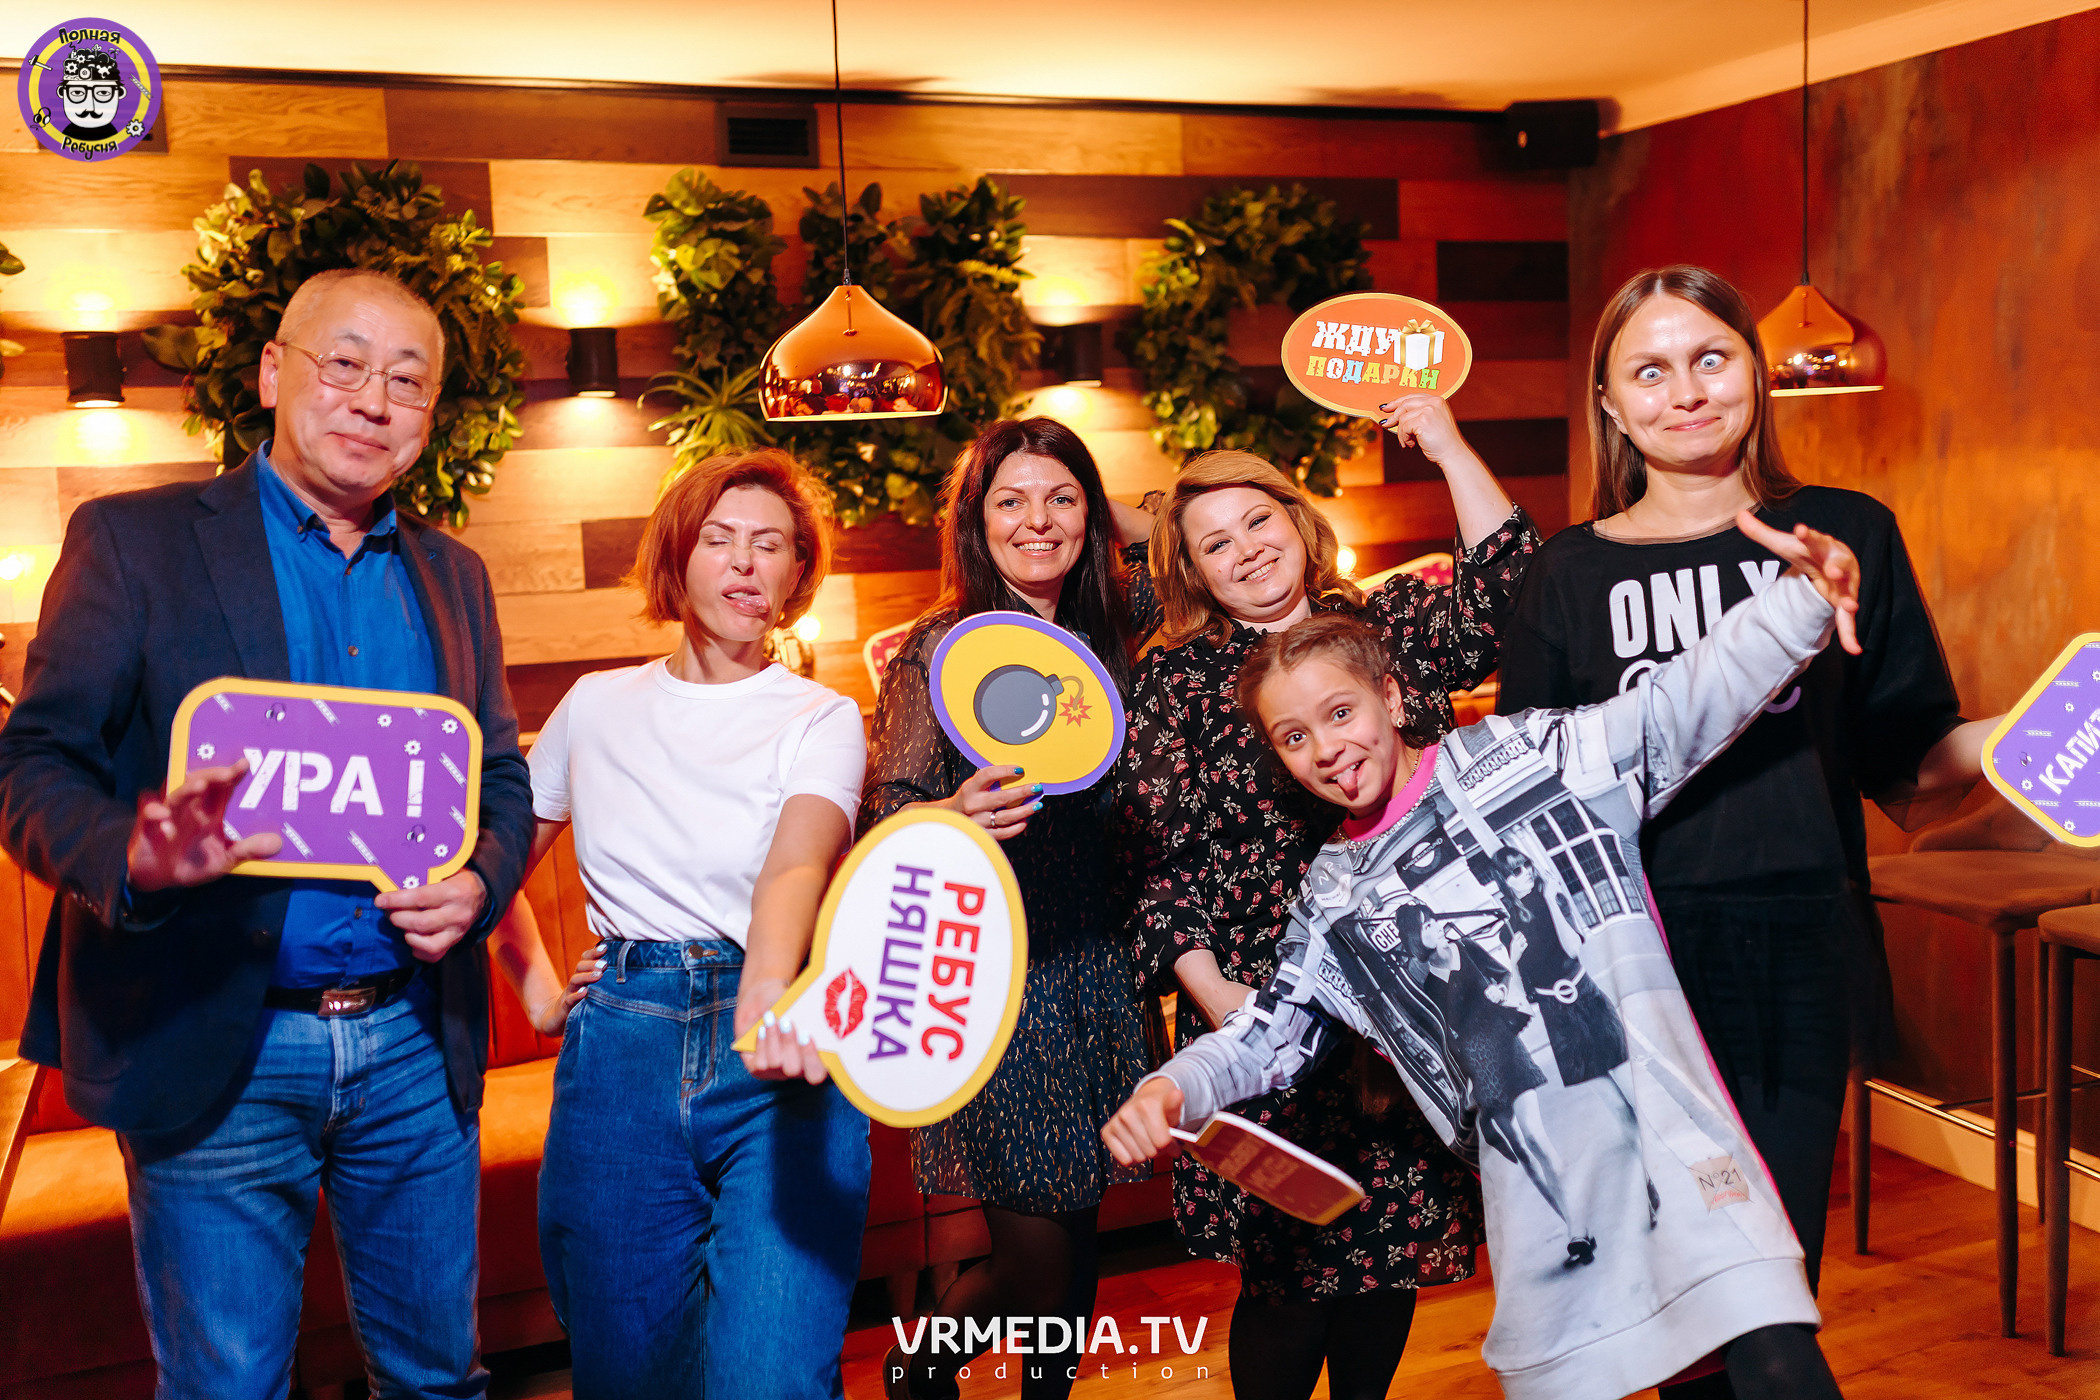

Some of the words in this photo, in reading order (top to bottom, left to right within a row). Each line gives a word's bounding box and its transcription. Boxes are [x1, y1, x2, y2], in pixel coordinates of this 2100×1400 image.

[1311, 320, 1401, 357] ЖДУ
[867, 863, 935, 1062] НЯШКА
[920, 881, 987, 1062] РЕБУС
